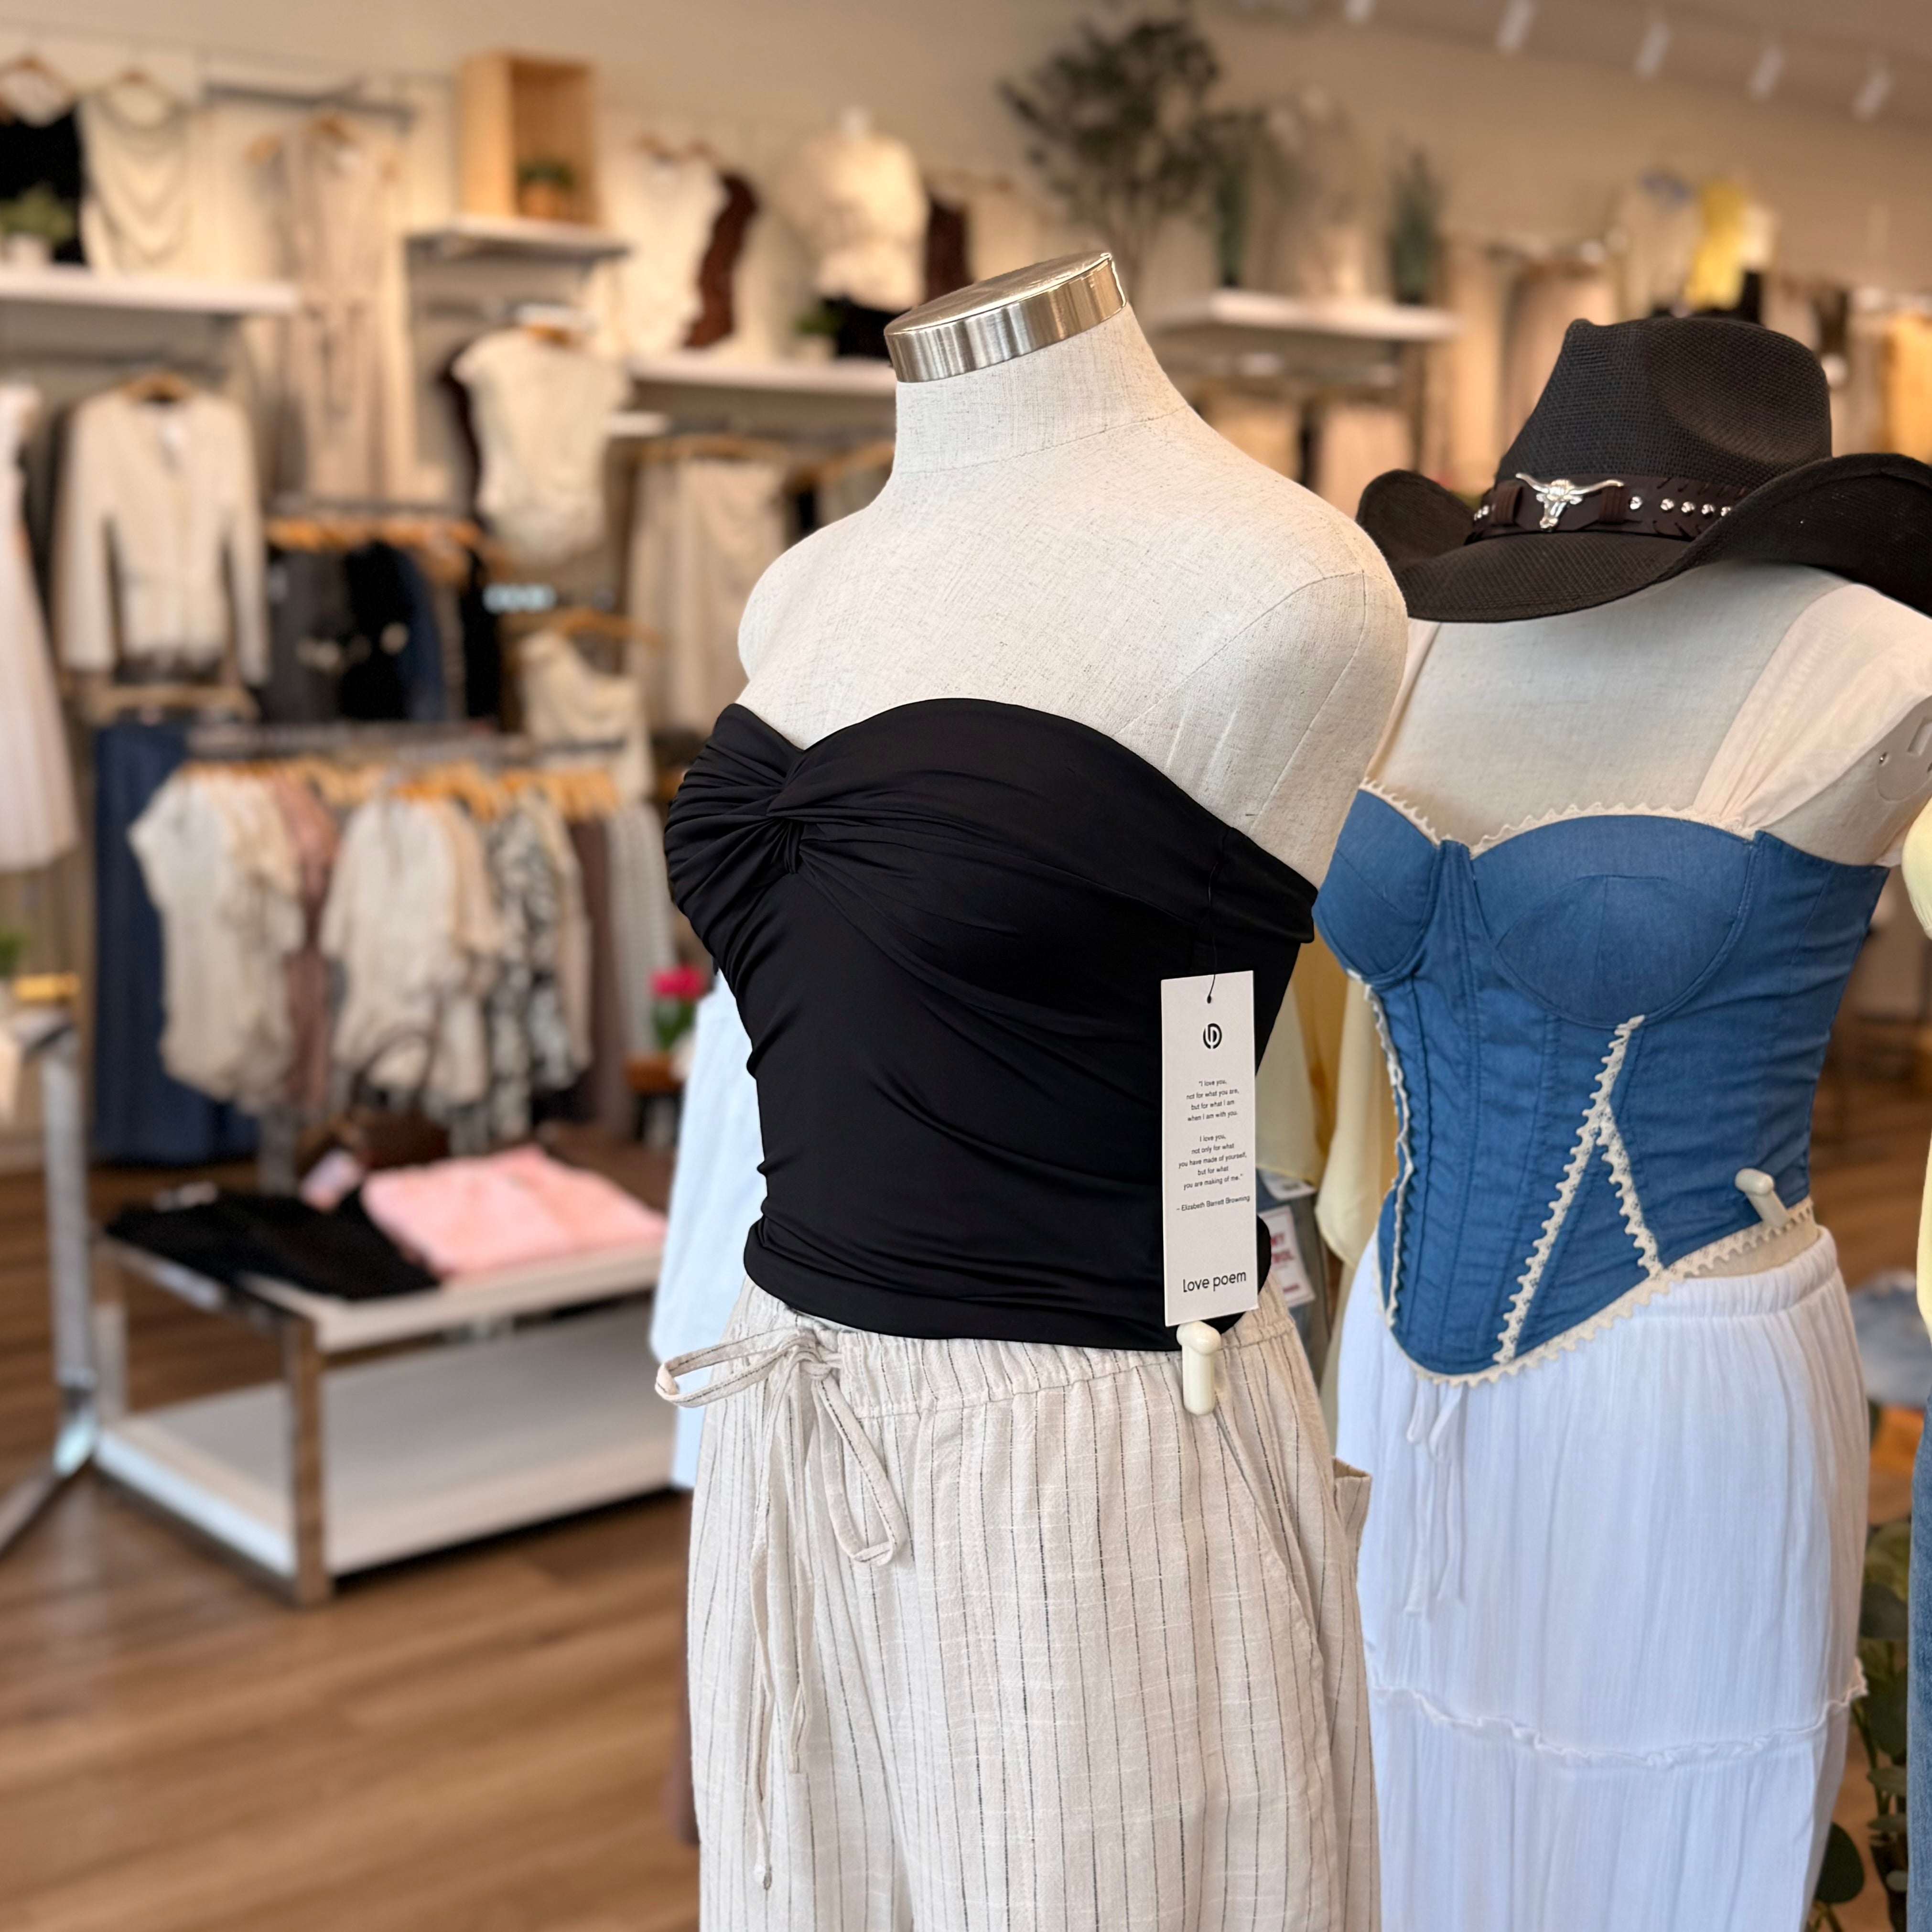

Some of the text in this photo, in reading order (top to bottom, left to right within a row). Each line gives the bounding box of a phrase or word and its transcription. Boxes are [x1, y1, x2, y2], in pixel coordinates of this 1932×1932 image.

[1226, 1152, 1247, 1162] yourself,
[1182, 1202, 1205, 1211] Elizabeth
[1226, 1196, 1250, 1204] Browning
[1183, 1272, 1246, 1292] Love poem
